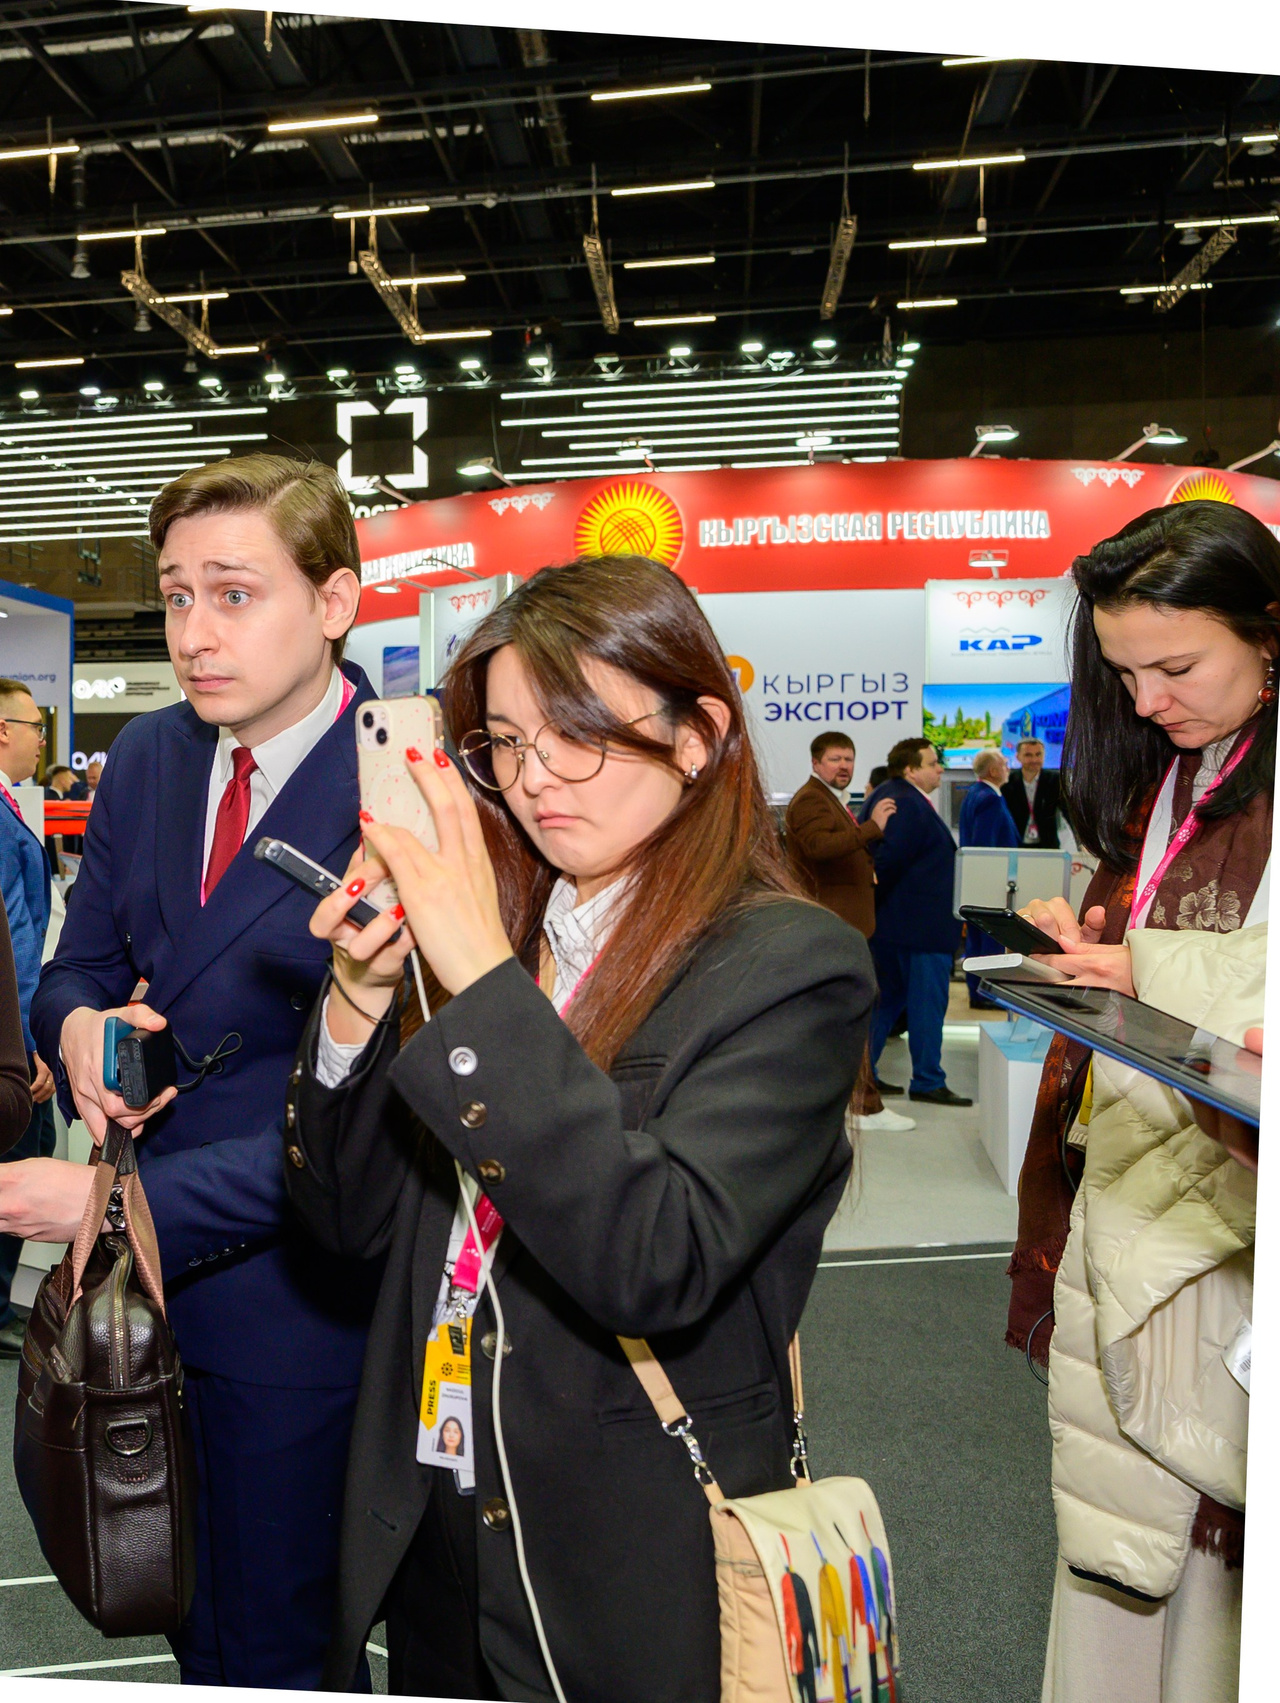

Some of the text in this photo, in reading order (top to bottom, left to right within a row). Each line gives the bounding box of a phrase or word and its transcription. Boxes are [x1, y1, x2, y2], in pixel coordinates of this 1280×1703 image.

[699, 510, 1051, 547] КЫРГЫЗСКАЯ РЕСПУБЛИКА
[763, 672, 910, 695] КЫРГЫЗ
[764, 700, 909, 722] ЭКСПОРТ
[427, 1379, 437, 1416] PRESS
